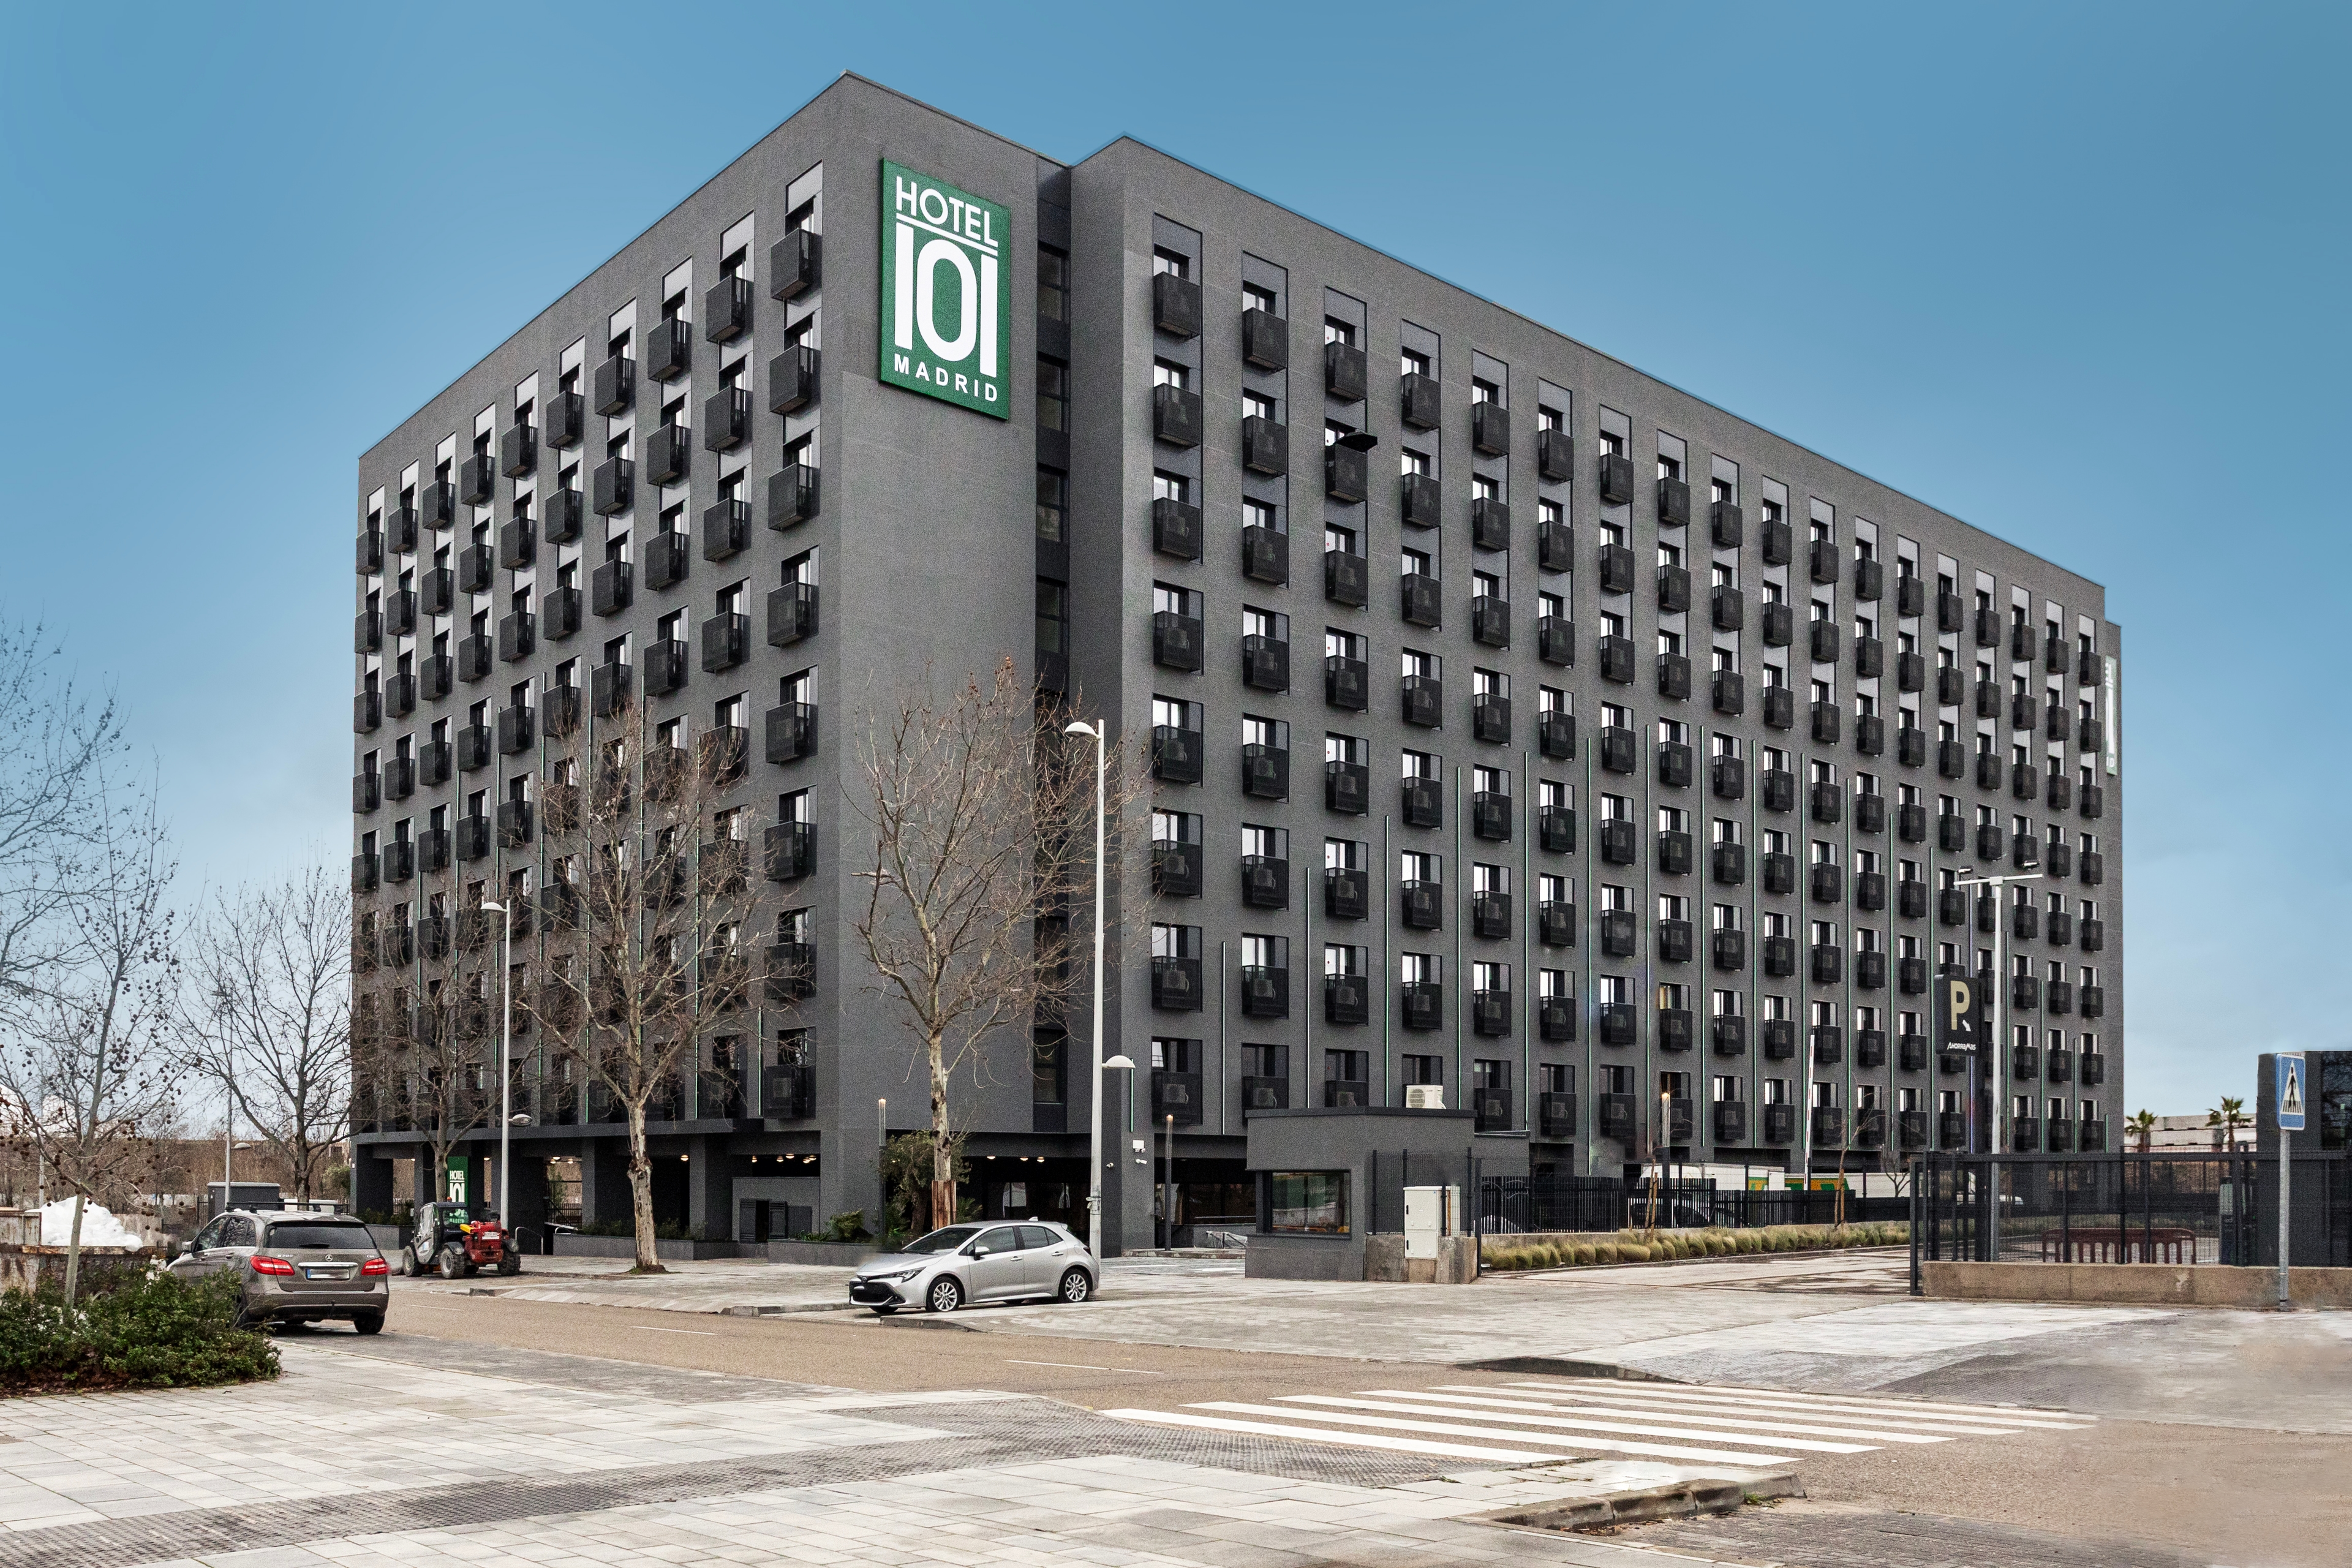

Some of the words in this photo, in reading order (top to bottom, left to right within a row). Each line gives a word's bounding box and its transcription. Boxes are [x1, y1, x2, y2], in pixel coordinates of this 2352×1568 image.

[896, 176, 998, 247] HOTEL
[894, 222, 998, 378] 101
[894, 353, 998, 402] MADRID
[1950, 981, 1970, 1030] P
[449, 1170, 465, 1180] HOTEL
